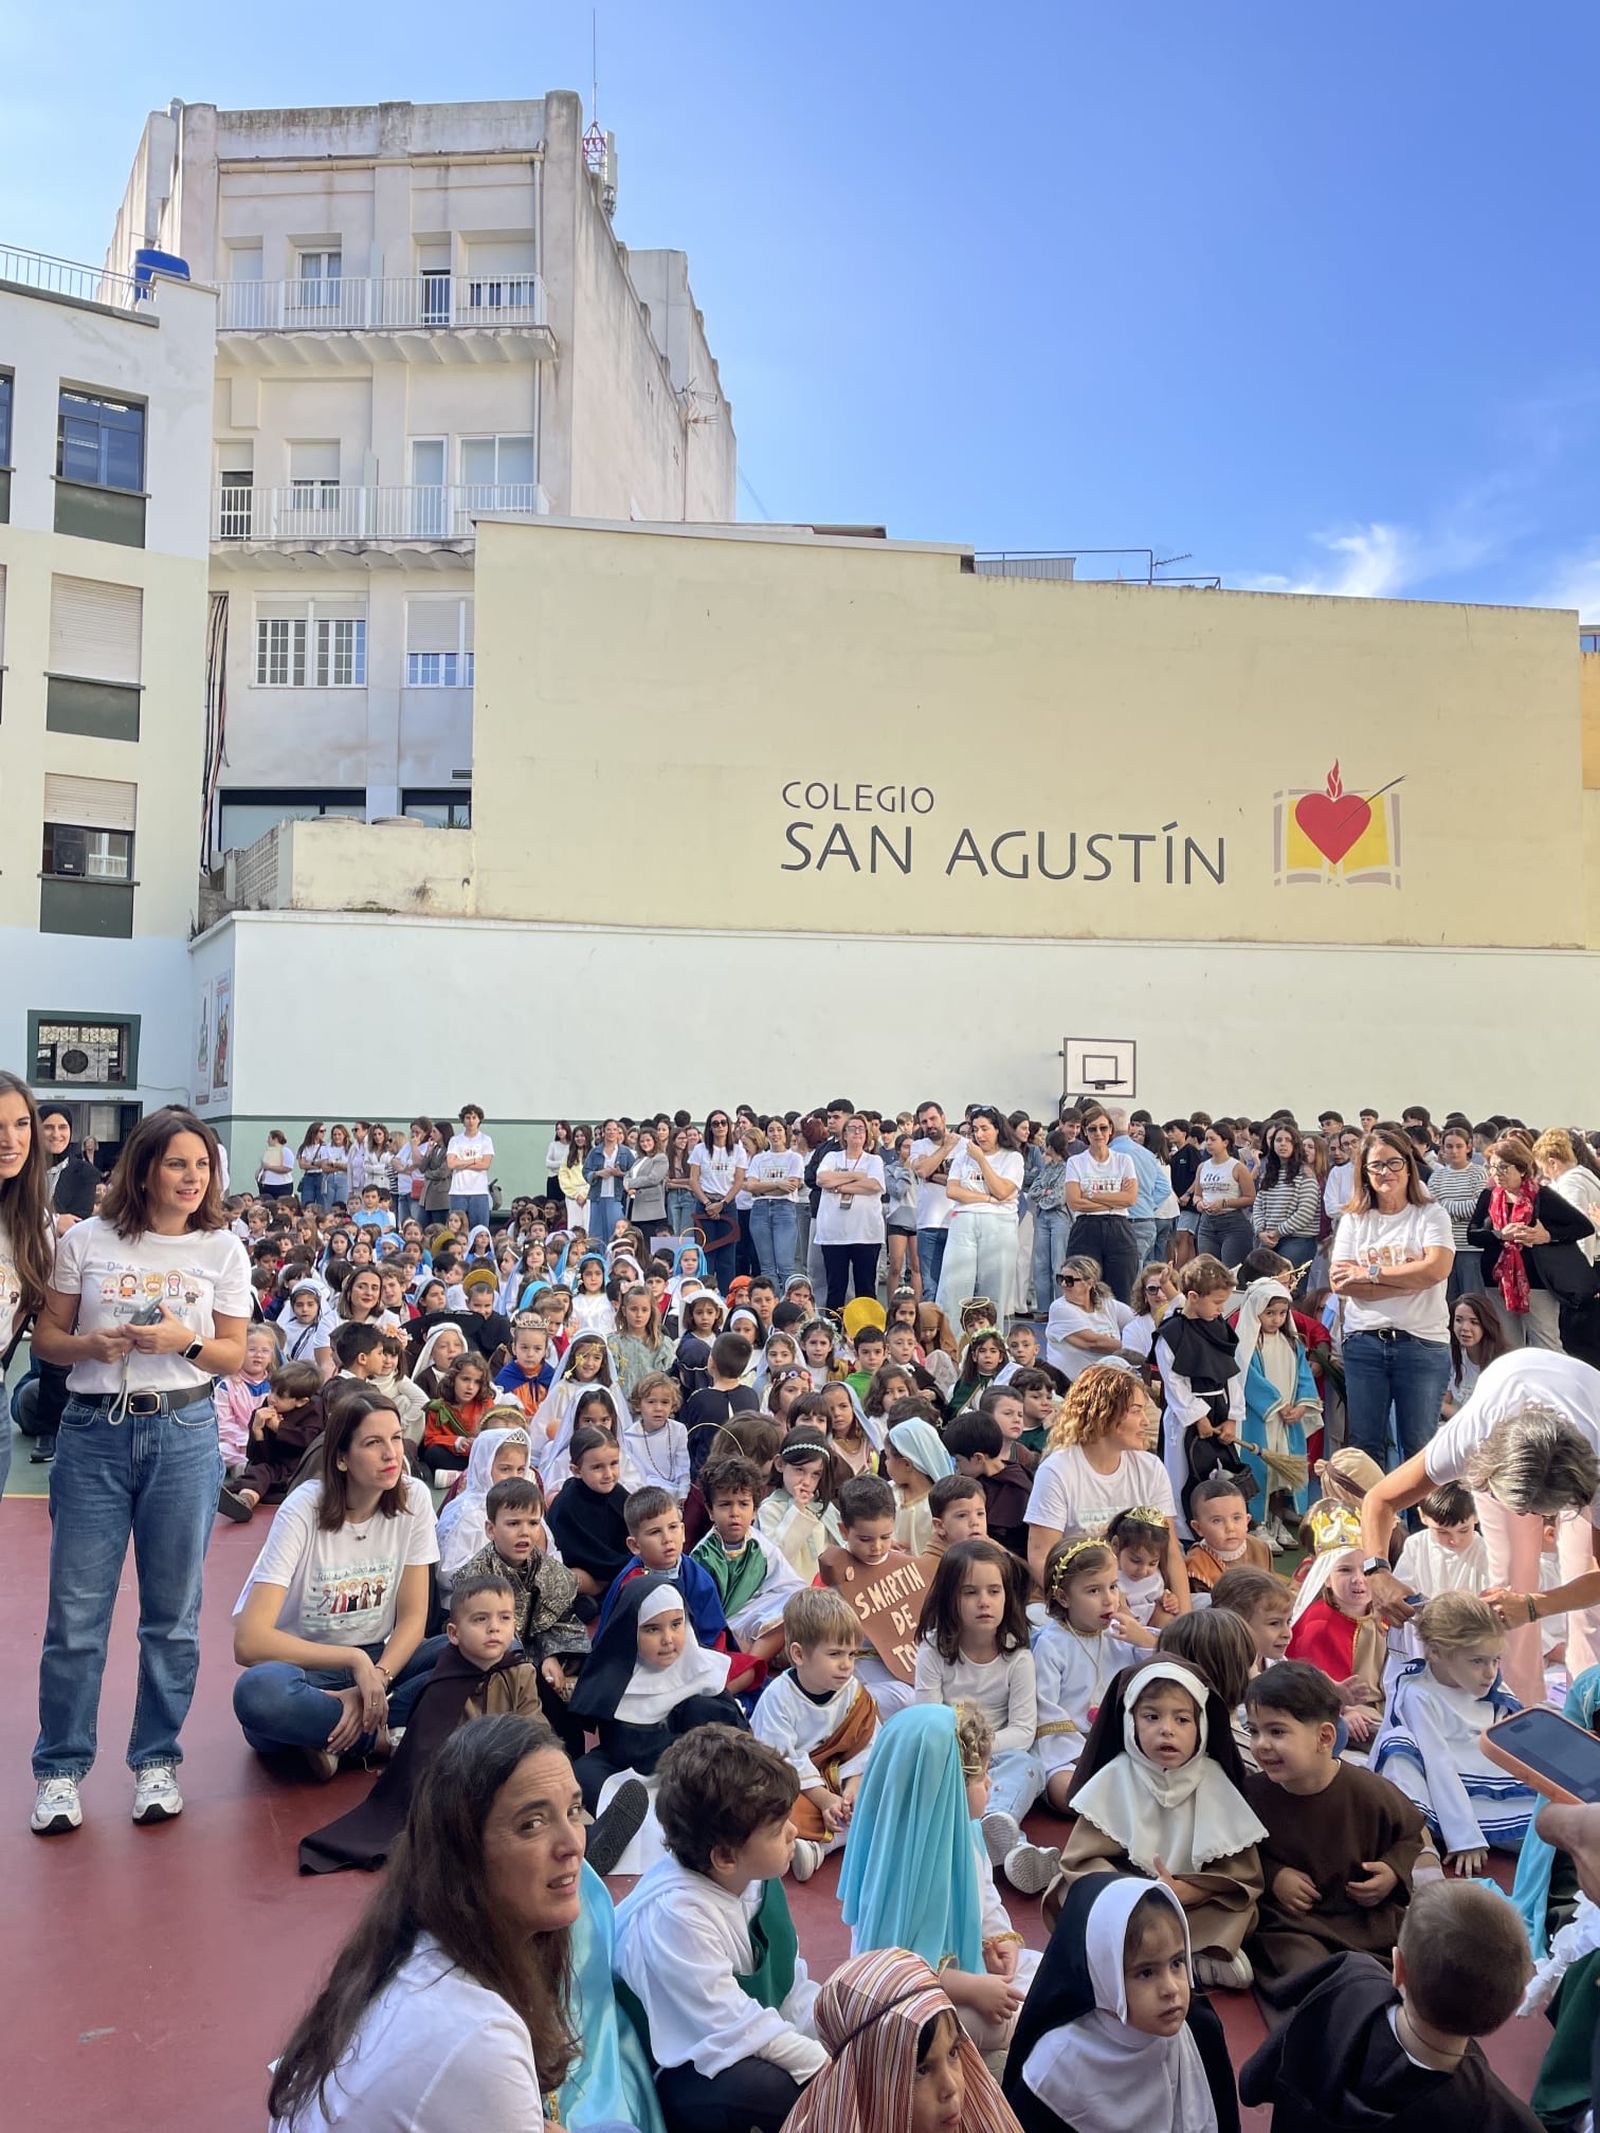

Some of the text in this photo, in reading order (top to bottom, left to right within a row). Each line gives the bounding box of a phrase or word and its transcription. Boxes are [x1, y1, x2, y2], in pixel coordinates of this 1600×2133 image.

[781, 781, 935, 815] COLEGIO
[781, 821, 1225, 885] SAN AGUSTÍN
[854, 1562, 926, 1620] S.MARTIN
[890, 1603, 917, 1636] DE
[892, 1640, 918, 1672] TO
